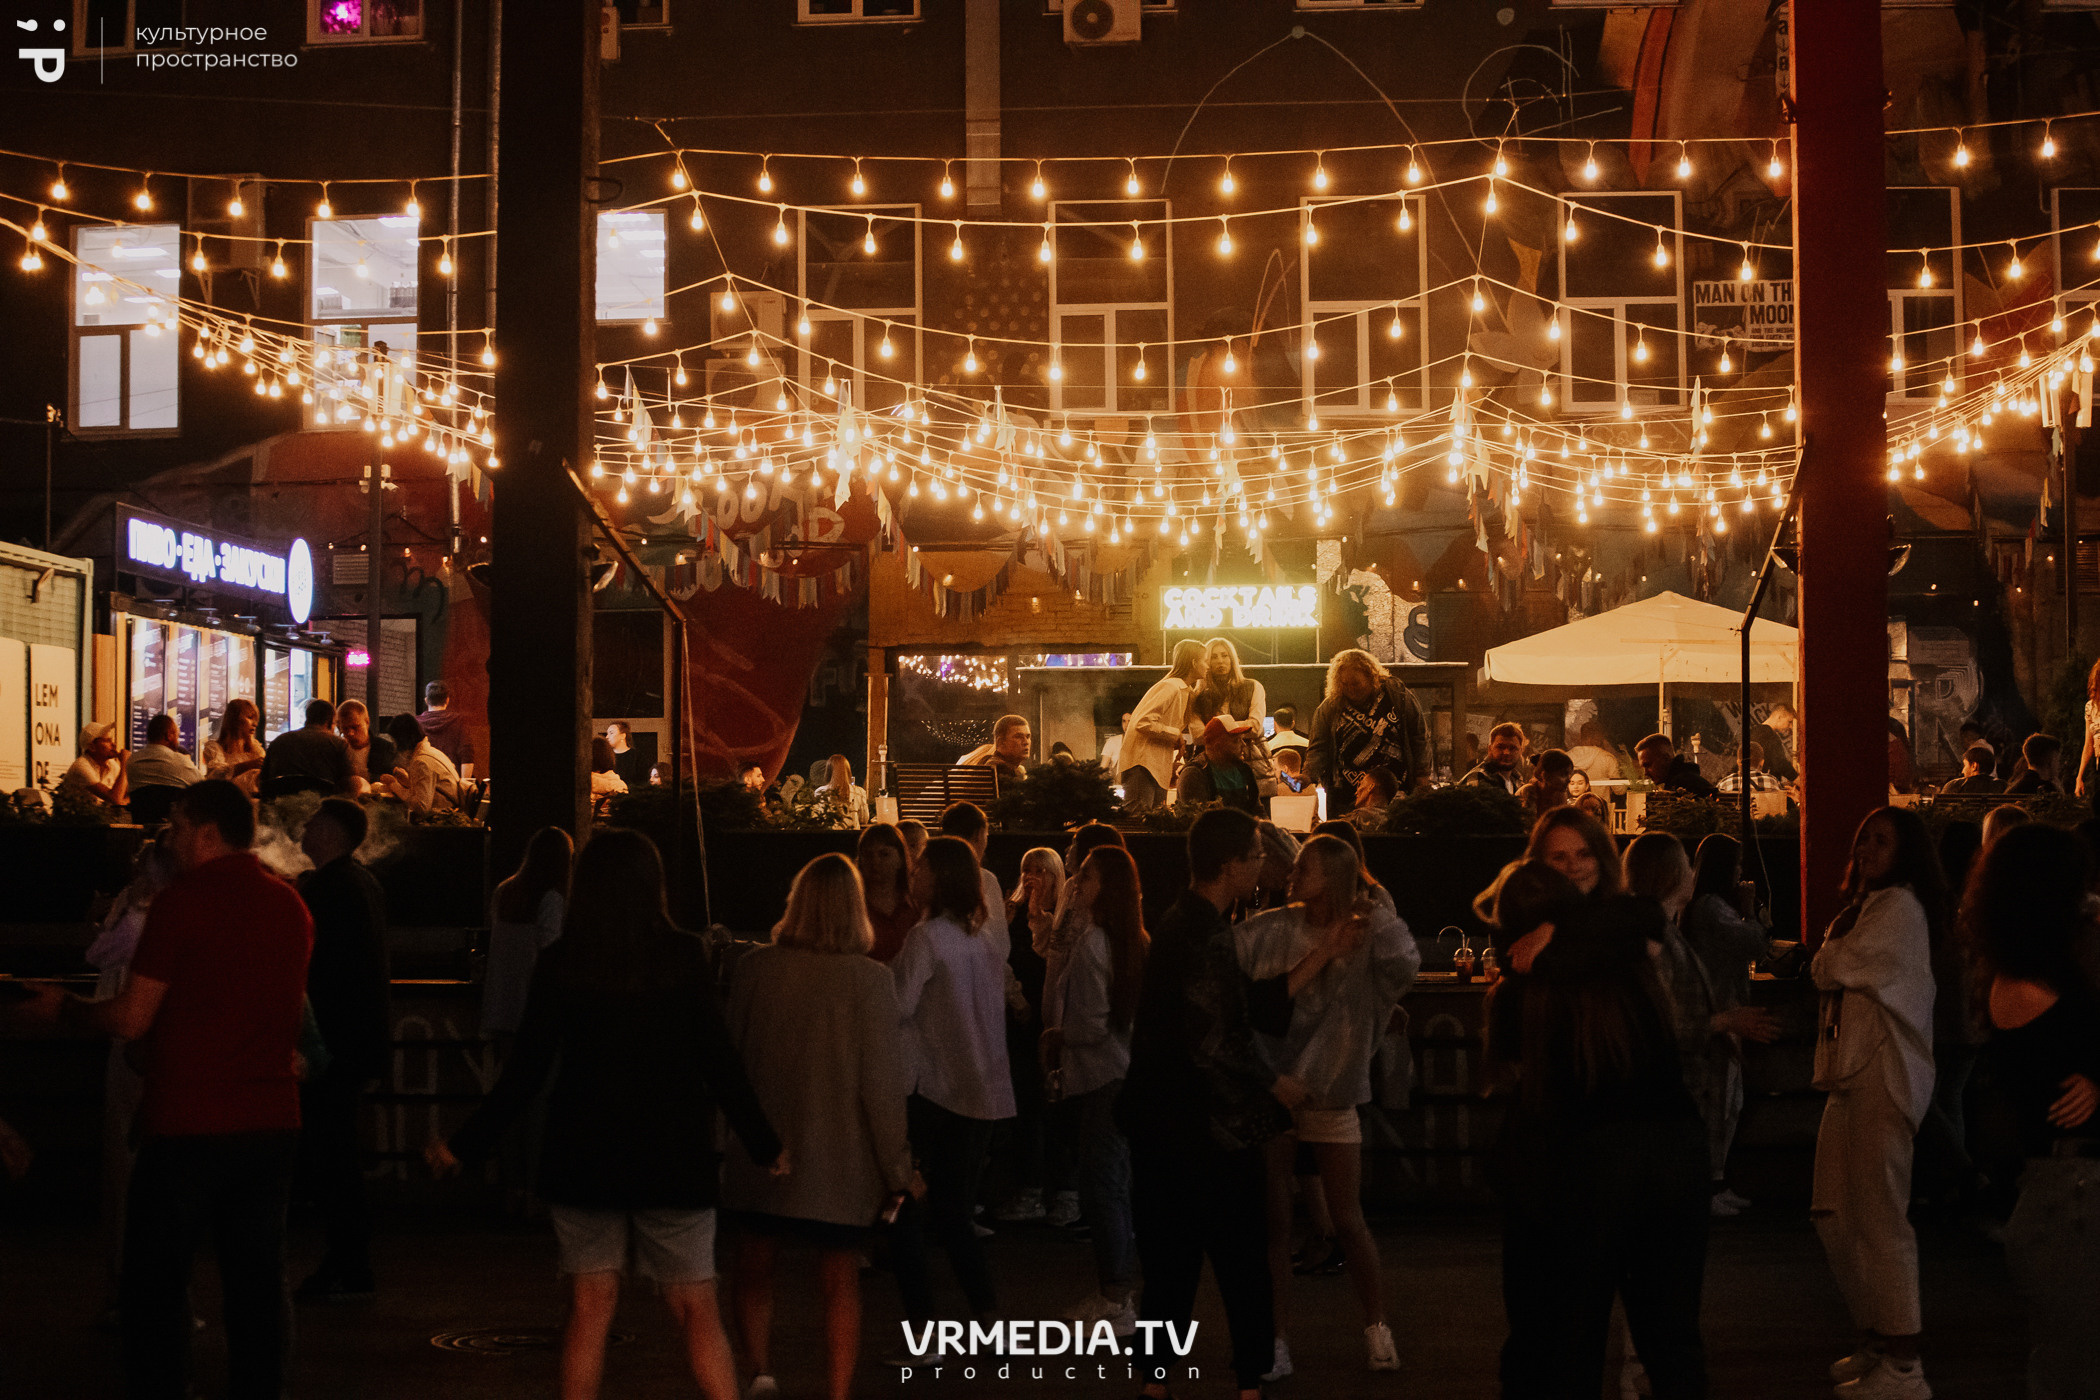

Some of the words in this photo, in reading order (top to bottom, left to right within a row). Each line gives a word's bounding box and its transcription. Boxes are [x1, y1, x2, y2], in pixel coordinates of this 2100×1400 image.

[1695, 283, 1735, 303] MAN
[1741, 283, 1765, 303] ON
[1770, 281, 1794, 302] TH
[1163, 585, 1317, 609] COCKTAILS
[1163, 606, 1223, 628] AND
[35, 683, 58, 708] LEM
[35, 721, 61, 747] ONA
